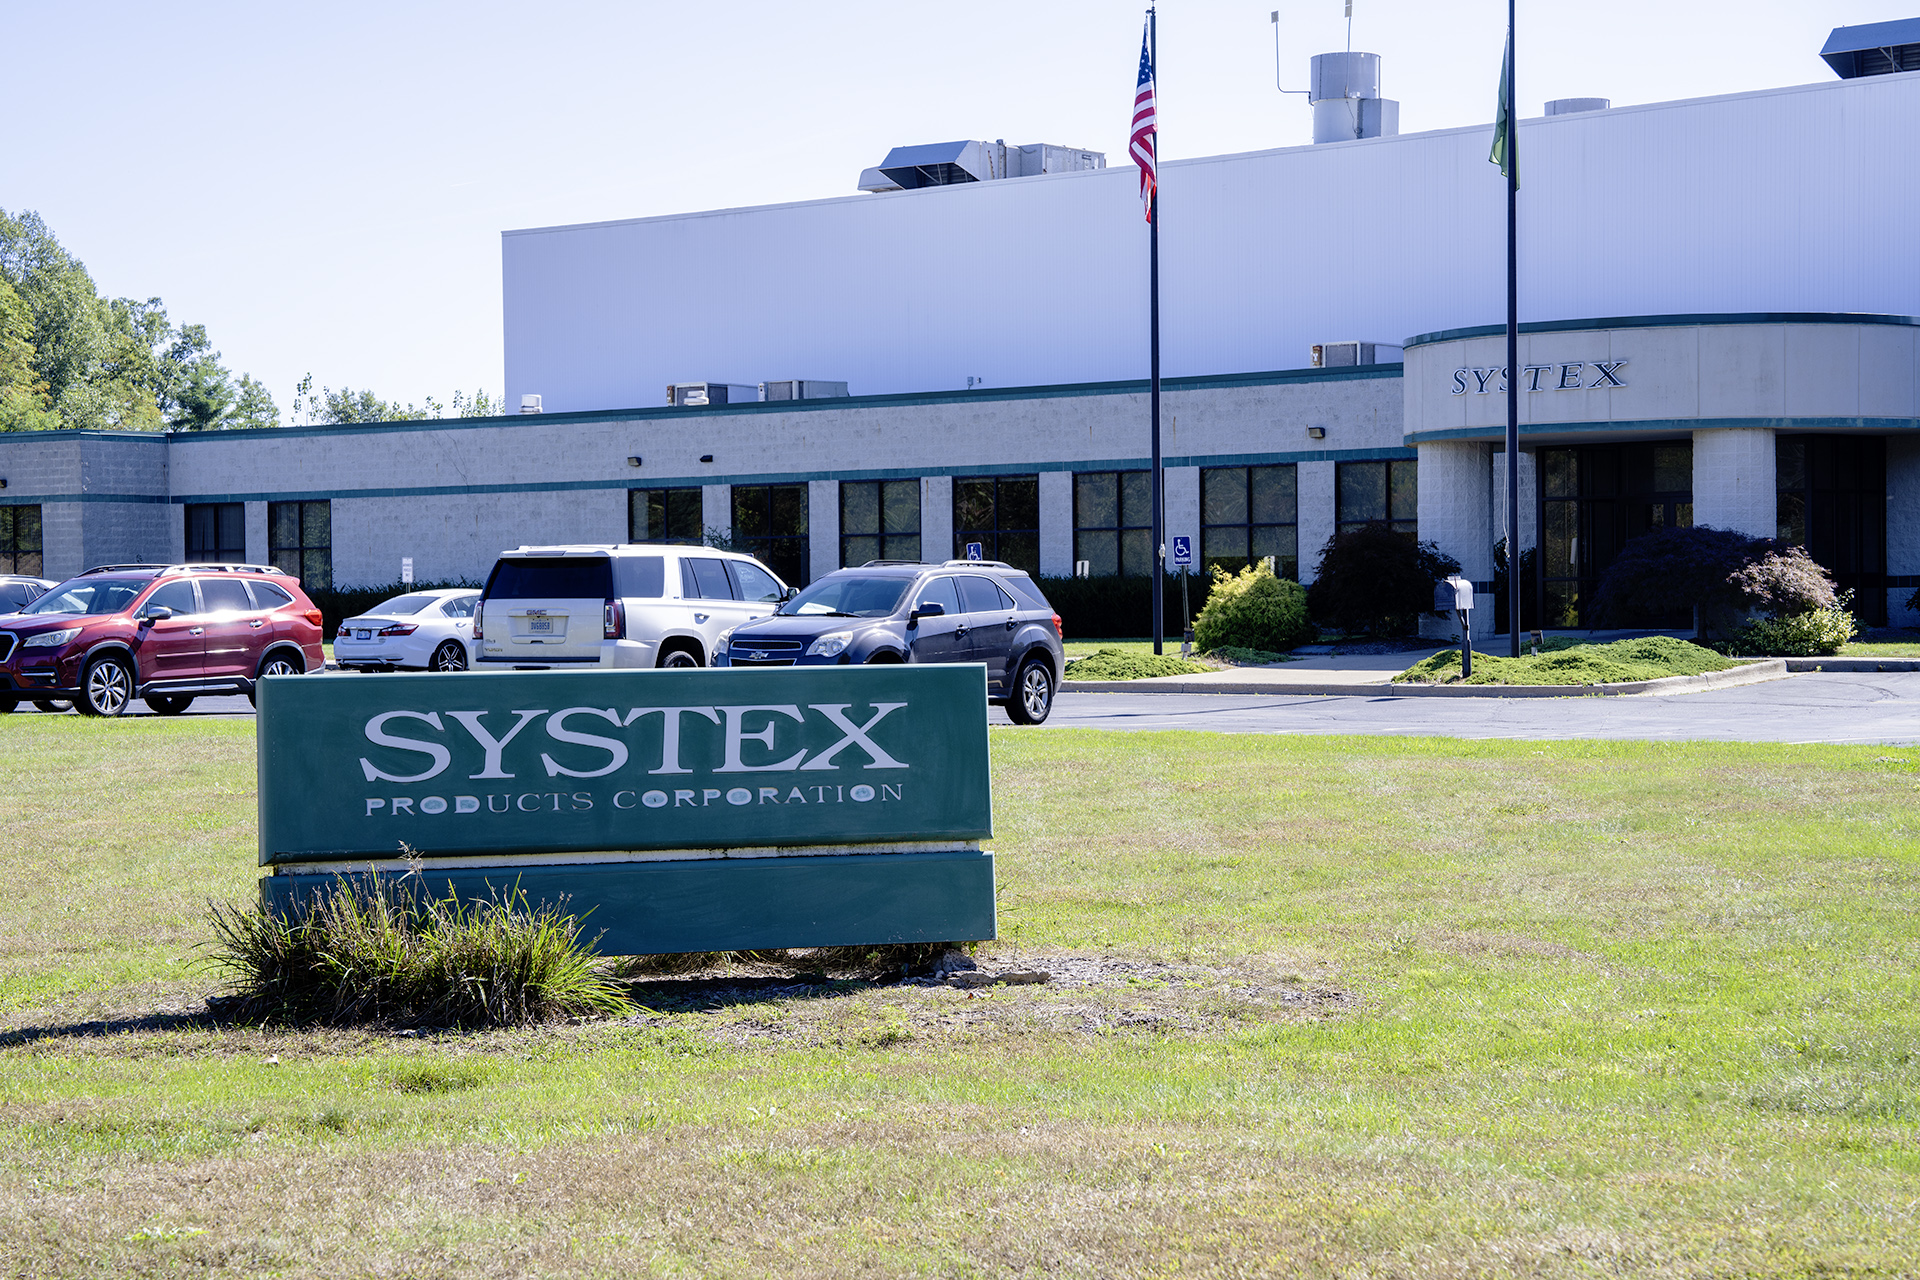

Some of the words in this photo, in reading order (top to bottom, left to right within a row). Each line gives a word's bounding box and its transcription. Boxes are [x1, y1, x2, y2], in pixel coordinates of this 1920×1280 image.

[359, 702, 910, 783] SYSTEX
[364, 791, 595, 816] PRODUCTS
[612, 783, 904, 809] CORPORATION
